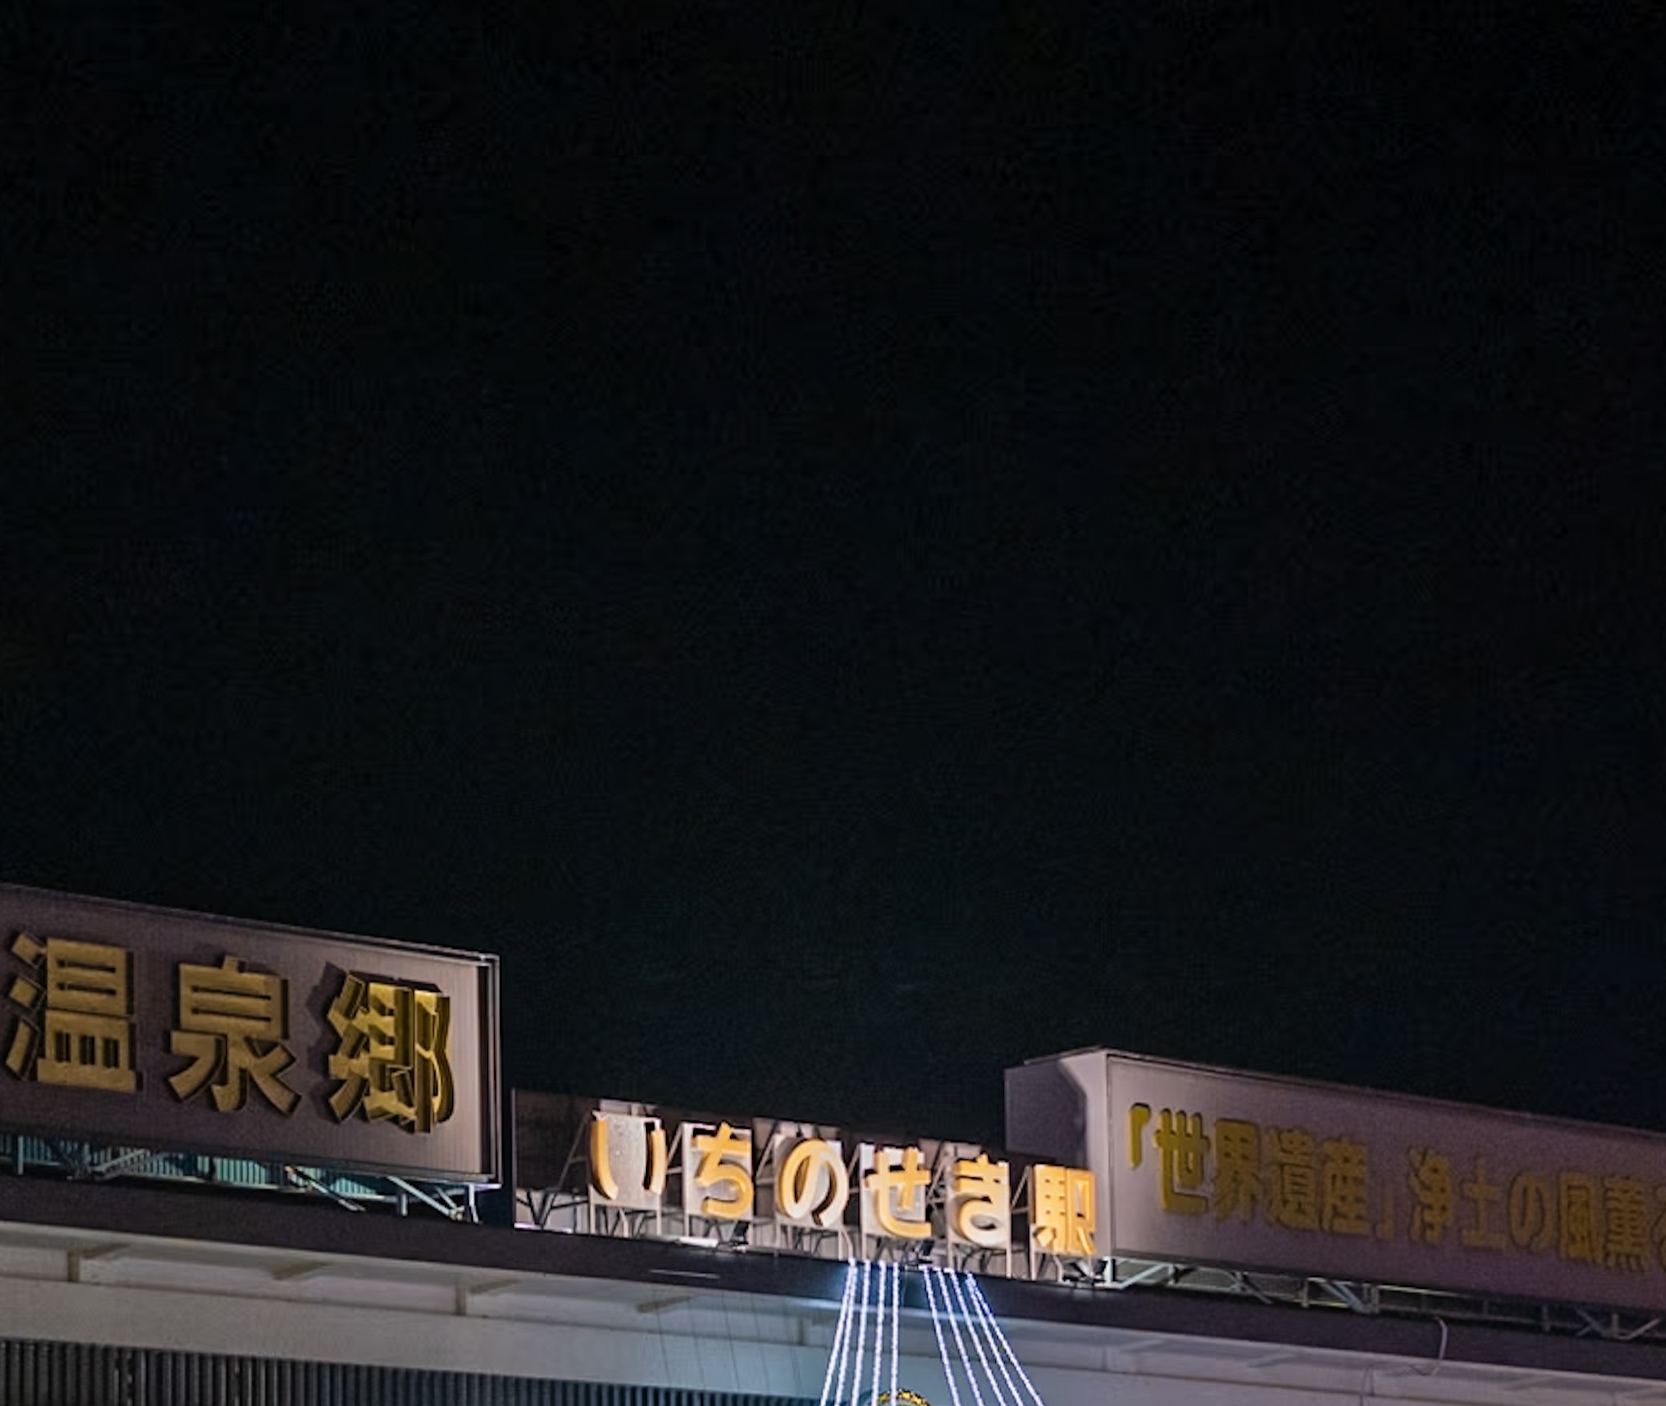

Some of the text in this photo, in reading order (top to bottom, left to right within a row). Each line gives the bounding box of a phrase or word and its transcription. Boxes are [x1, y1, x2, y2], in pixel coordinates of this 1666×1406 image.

[590, 1115, 1097, 1257] いちのせき駅
